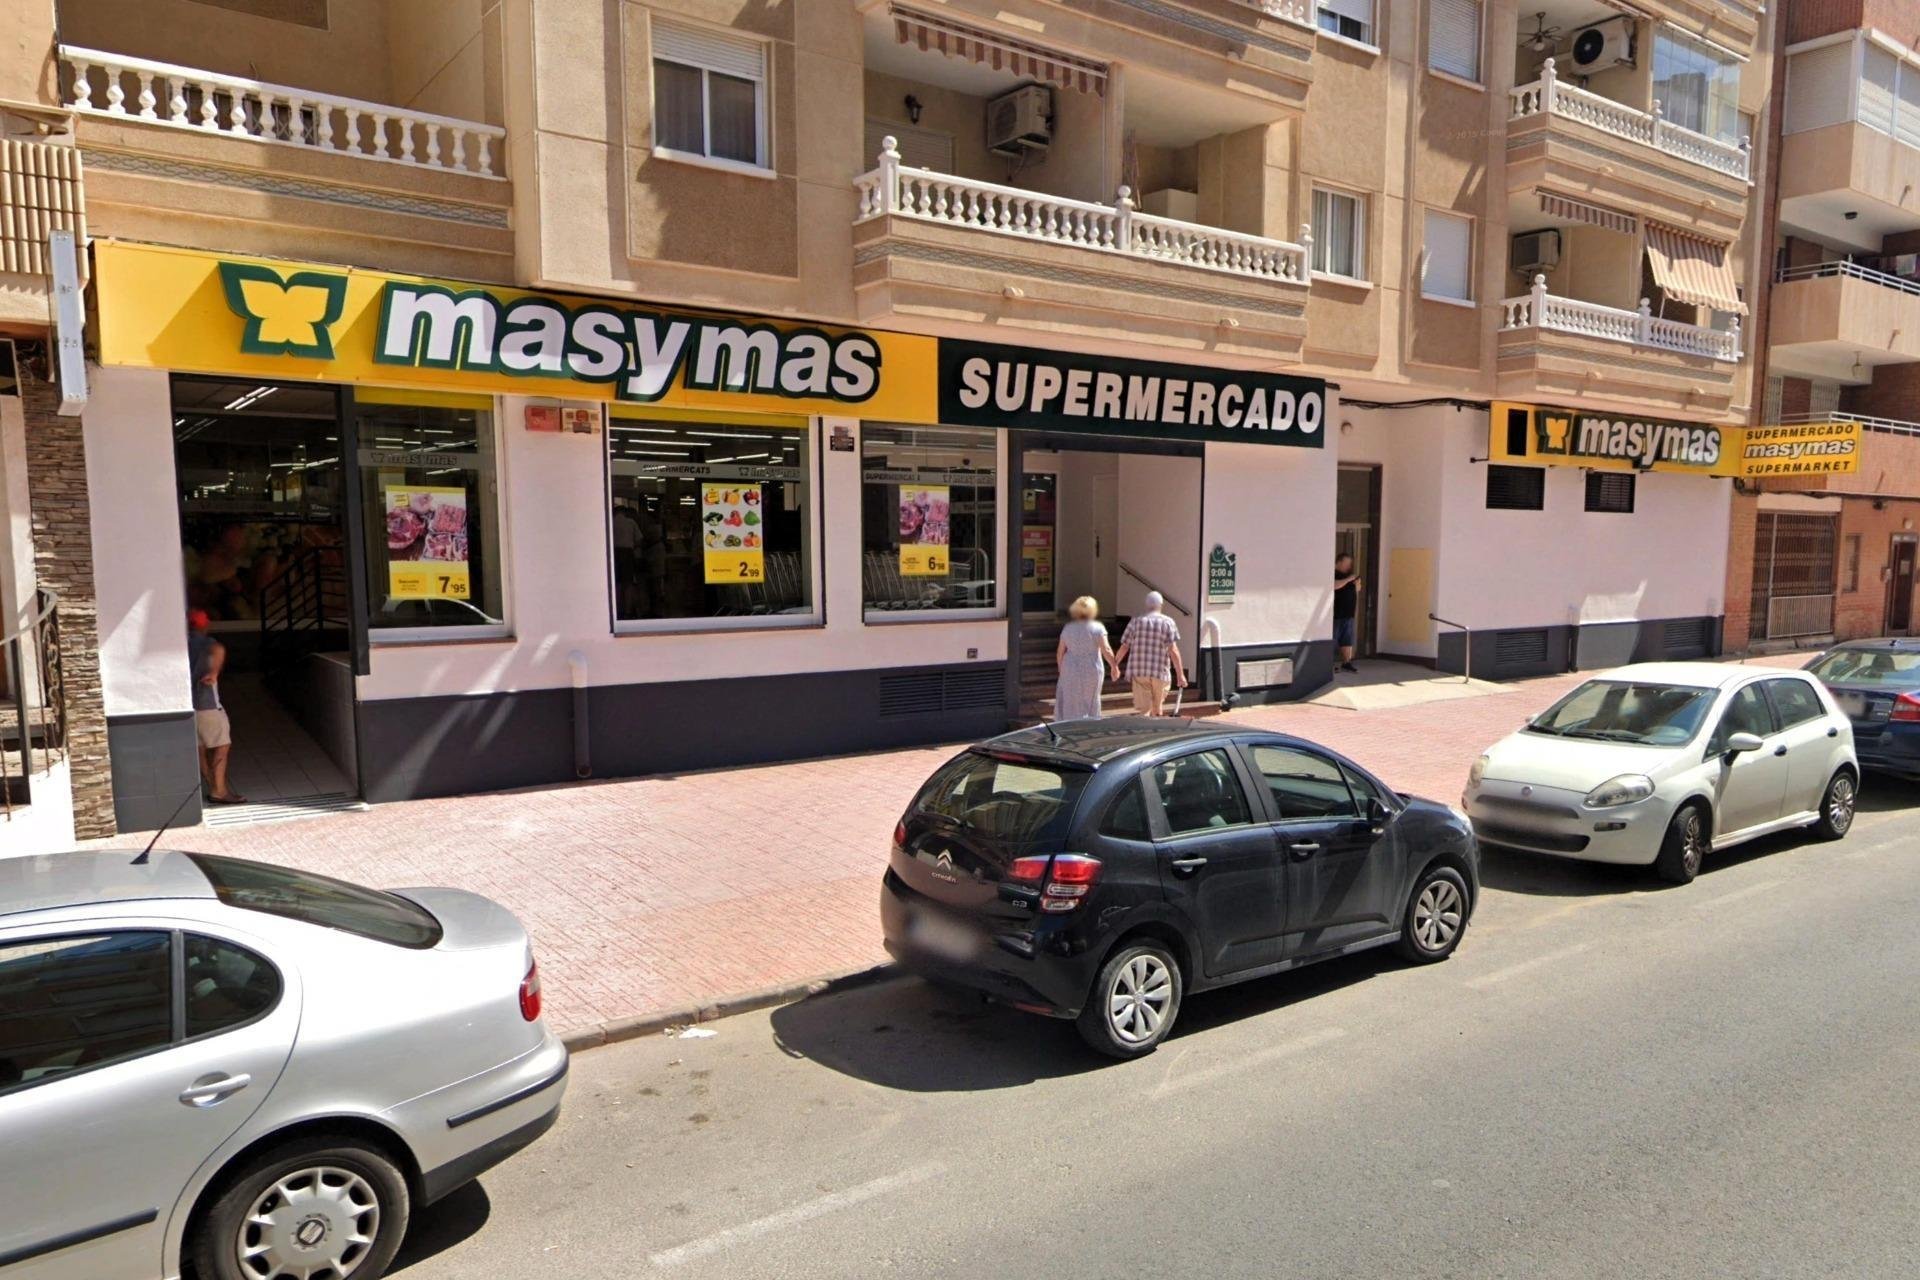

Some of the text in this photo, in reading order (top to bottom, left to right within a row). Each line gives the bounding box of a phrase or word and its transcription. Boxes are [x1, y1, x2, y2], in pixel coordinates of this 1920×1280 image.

[384, 288, 879, 397] masymas
[959, 357, 1322, 434] SUPERMERCADO
[1578, 417, 1720, 466] masymas
[1744, 439, 1856, 459] masymas
[1746, 424, 1854, 440] SUPERMERCADO
[1747, 461, 1851, 474] SUPERMARKET
